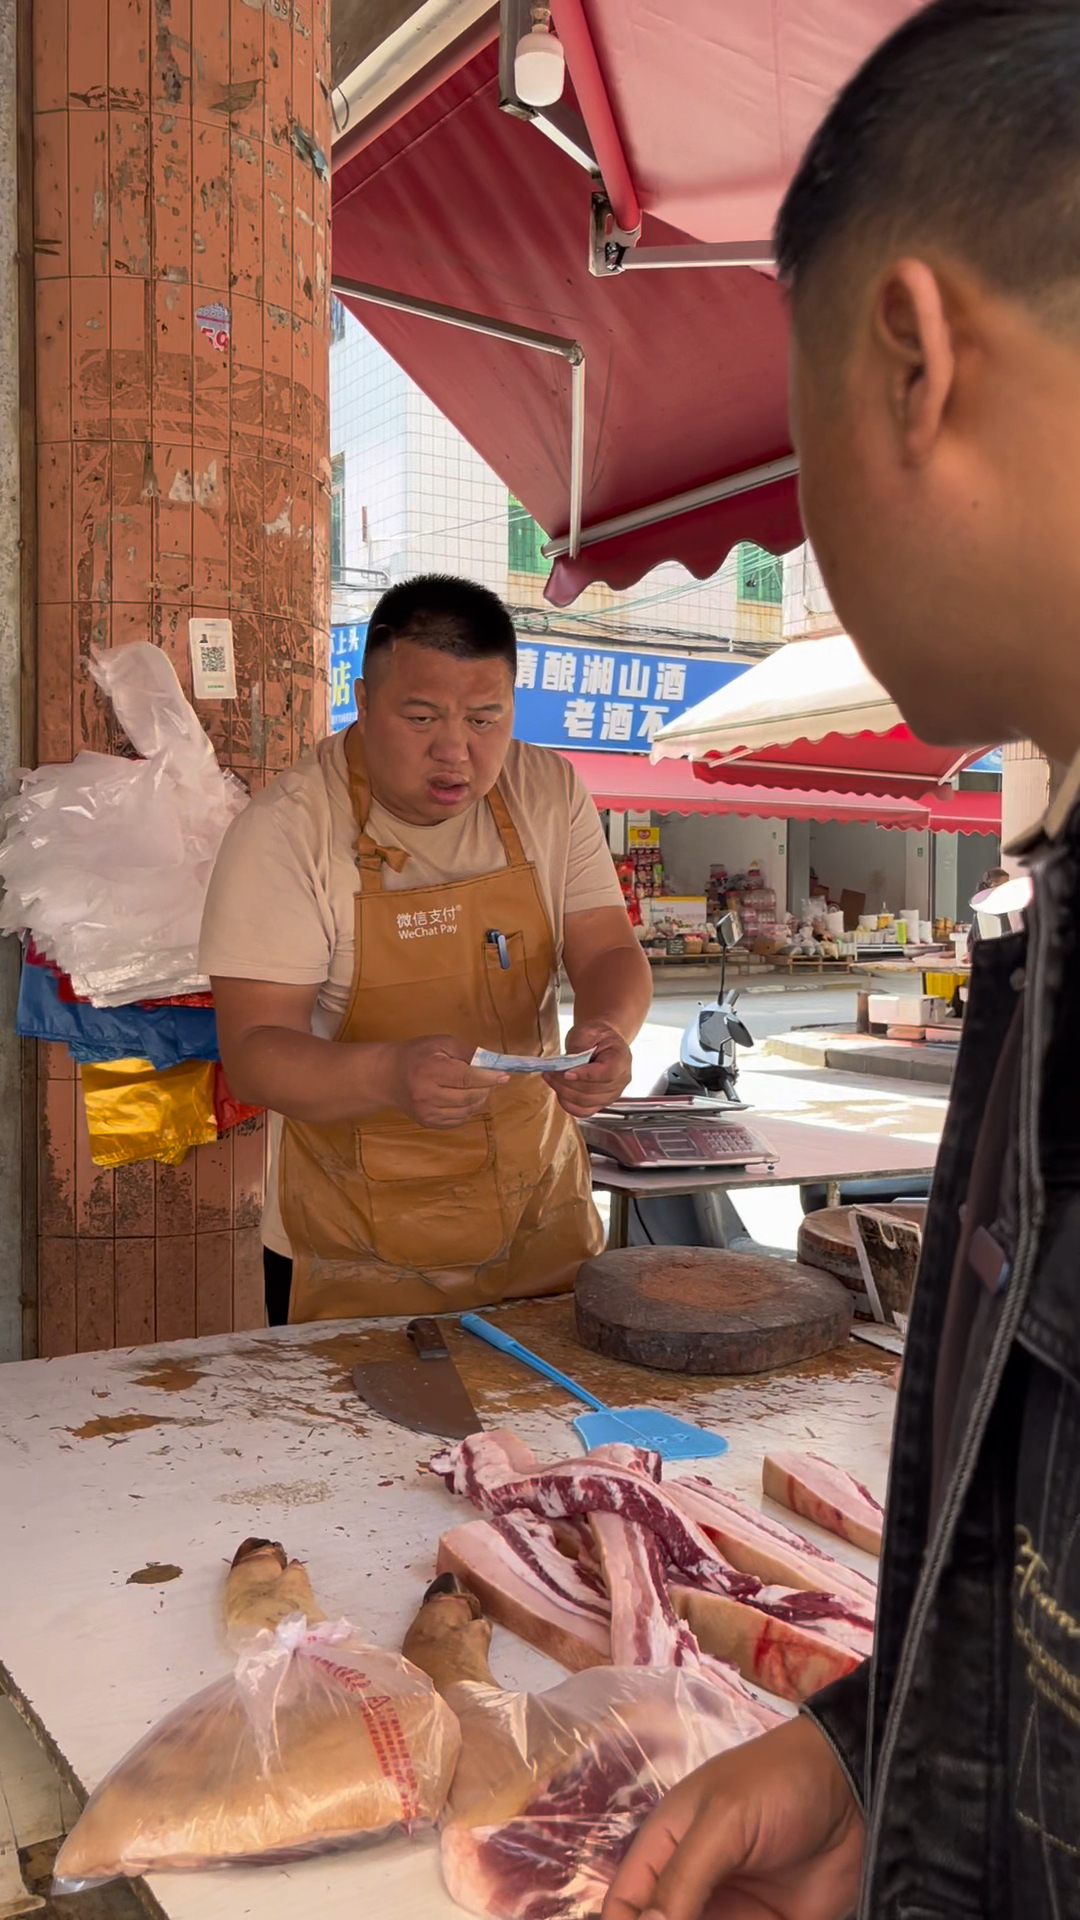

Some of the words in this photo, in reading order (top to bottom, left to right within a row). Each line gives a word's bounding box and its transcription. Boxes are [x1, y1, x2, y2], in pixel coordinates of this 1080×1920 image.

[563, 698, 691, 744] 老酒不
[396, 905, 456, 928] 微信支付
[398, 926, 438, 939] WeChat
[440, 924, 458, 934] Pay
